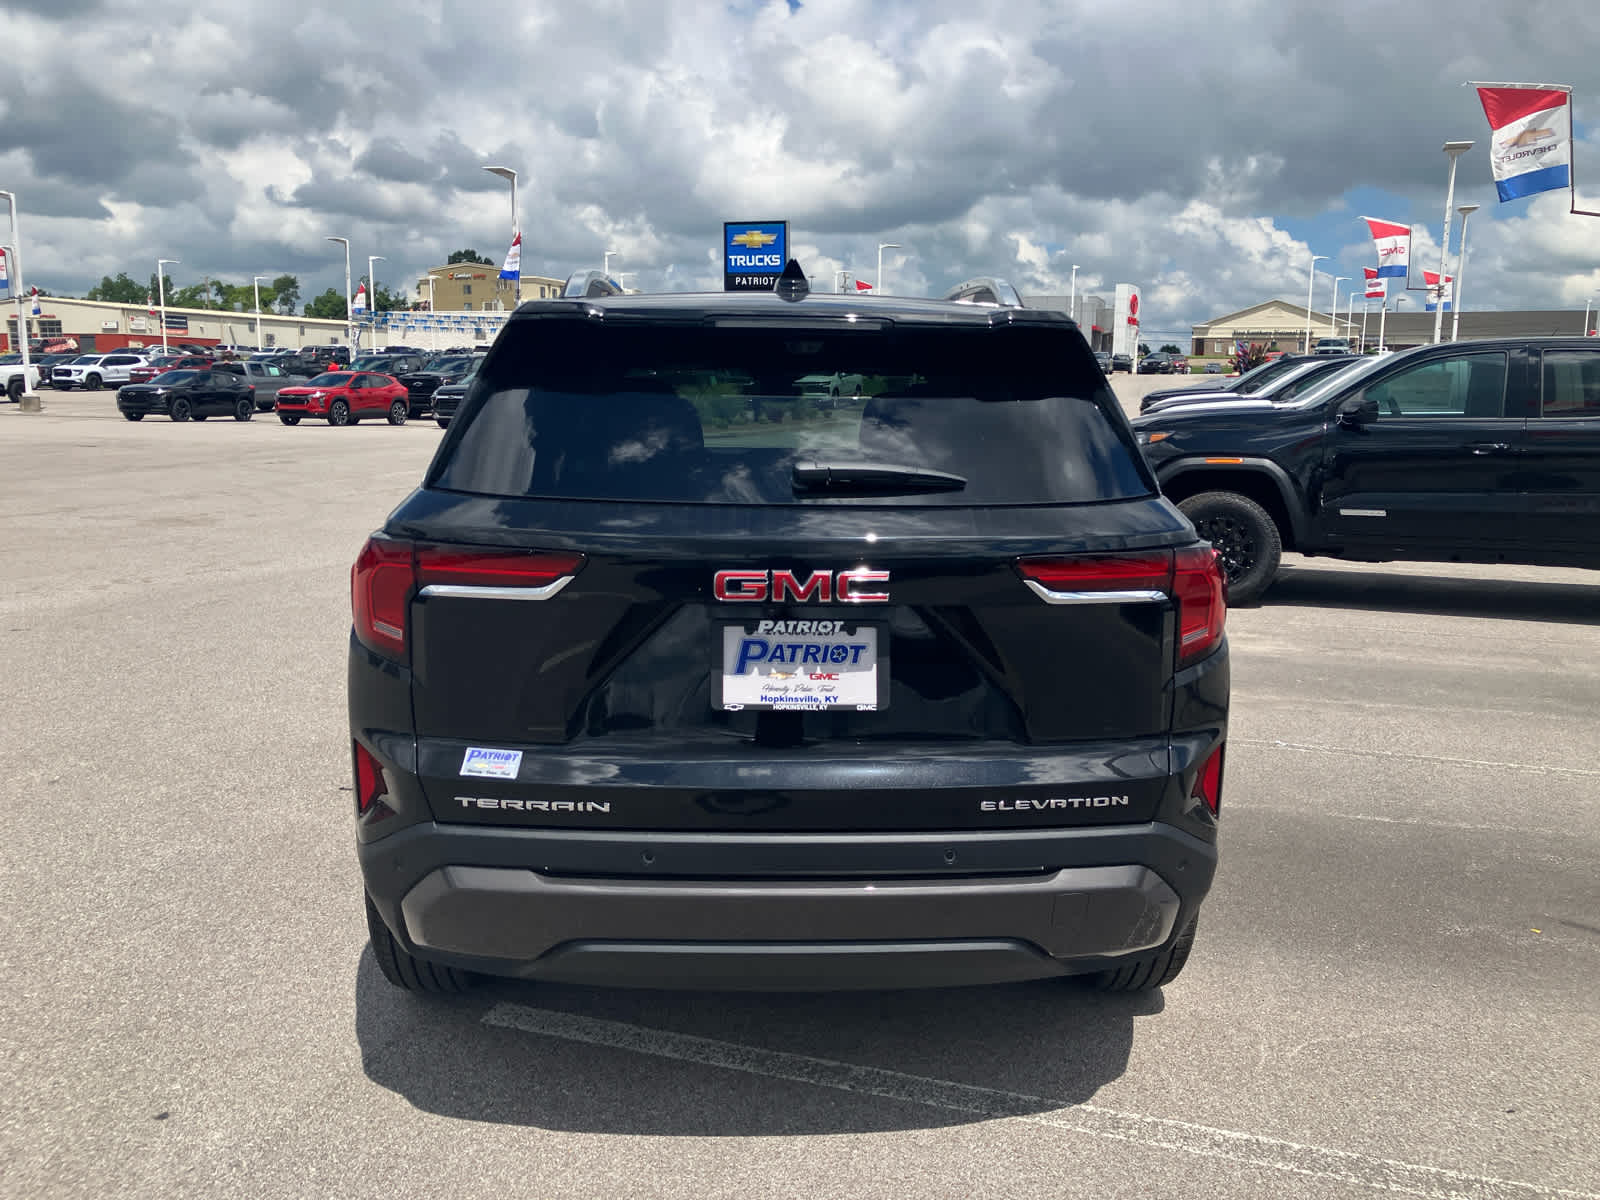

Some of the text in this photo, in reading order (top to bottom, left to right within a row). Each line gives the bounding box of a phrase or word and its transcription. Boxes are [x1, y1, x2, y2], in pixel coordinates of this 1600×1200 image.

[729, 254, 781, 267] TRUCKS
[735, 276, 775, 286] PATRIOT
[714, 569, 890, 602] GMC
[757, 620, 844, 634] PATRIOT
[735, 639, 866, 675] PATRIOT
[809, 673, 840, 681] GMC
[760, 695, 839, 704] Hopkinsville, KY
[773, 704, 818, 712] HOPKINSVILLE,
[466, 749, 520, 763] PATRIOT
[454, 796, 611, 813] TERRAIN
[980, 795, 1129, 811] ELEVATION
